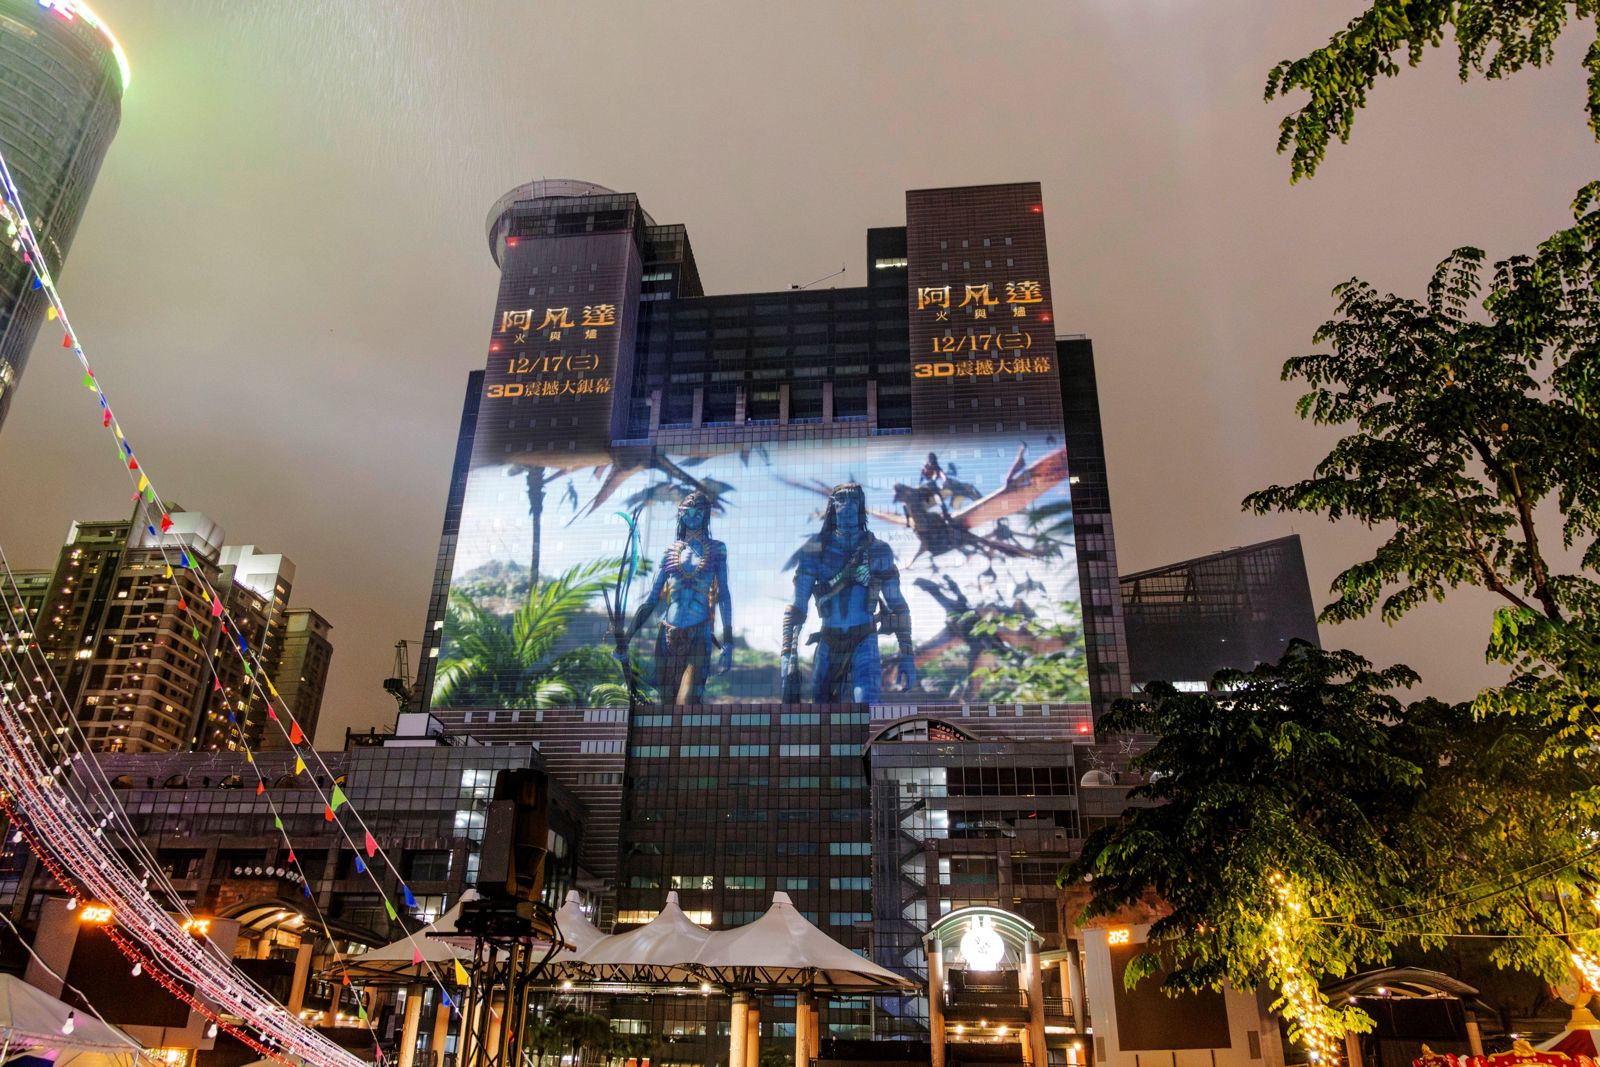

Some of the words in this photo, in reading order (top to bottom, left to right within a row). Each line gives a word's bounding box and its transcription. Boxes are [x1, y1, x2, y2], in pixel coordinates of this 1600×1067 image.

[917, 281, 1044, 310] 阿凡達
[500, 304, 616, 333] 阿凡達
[932, 332, 1032, 353] 12/17(三)
[507, 354, 600, 374] 12/17(三)
[914, 357, 1051, 378] 3D震撼大銀幕
[486, 377, 612, 398] 3D震撼大銀幕
